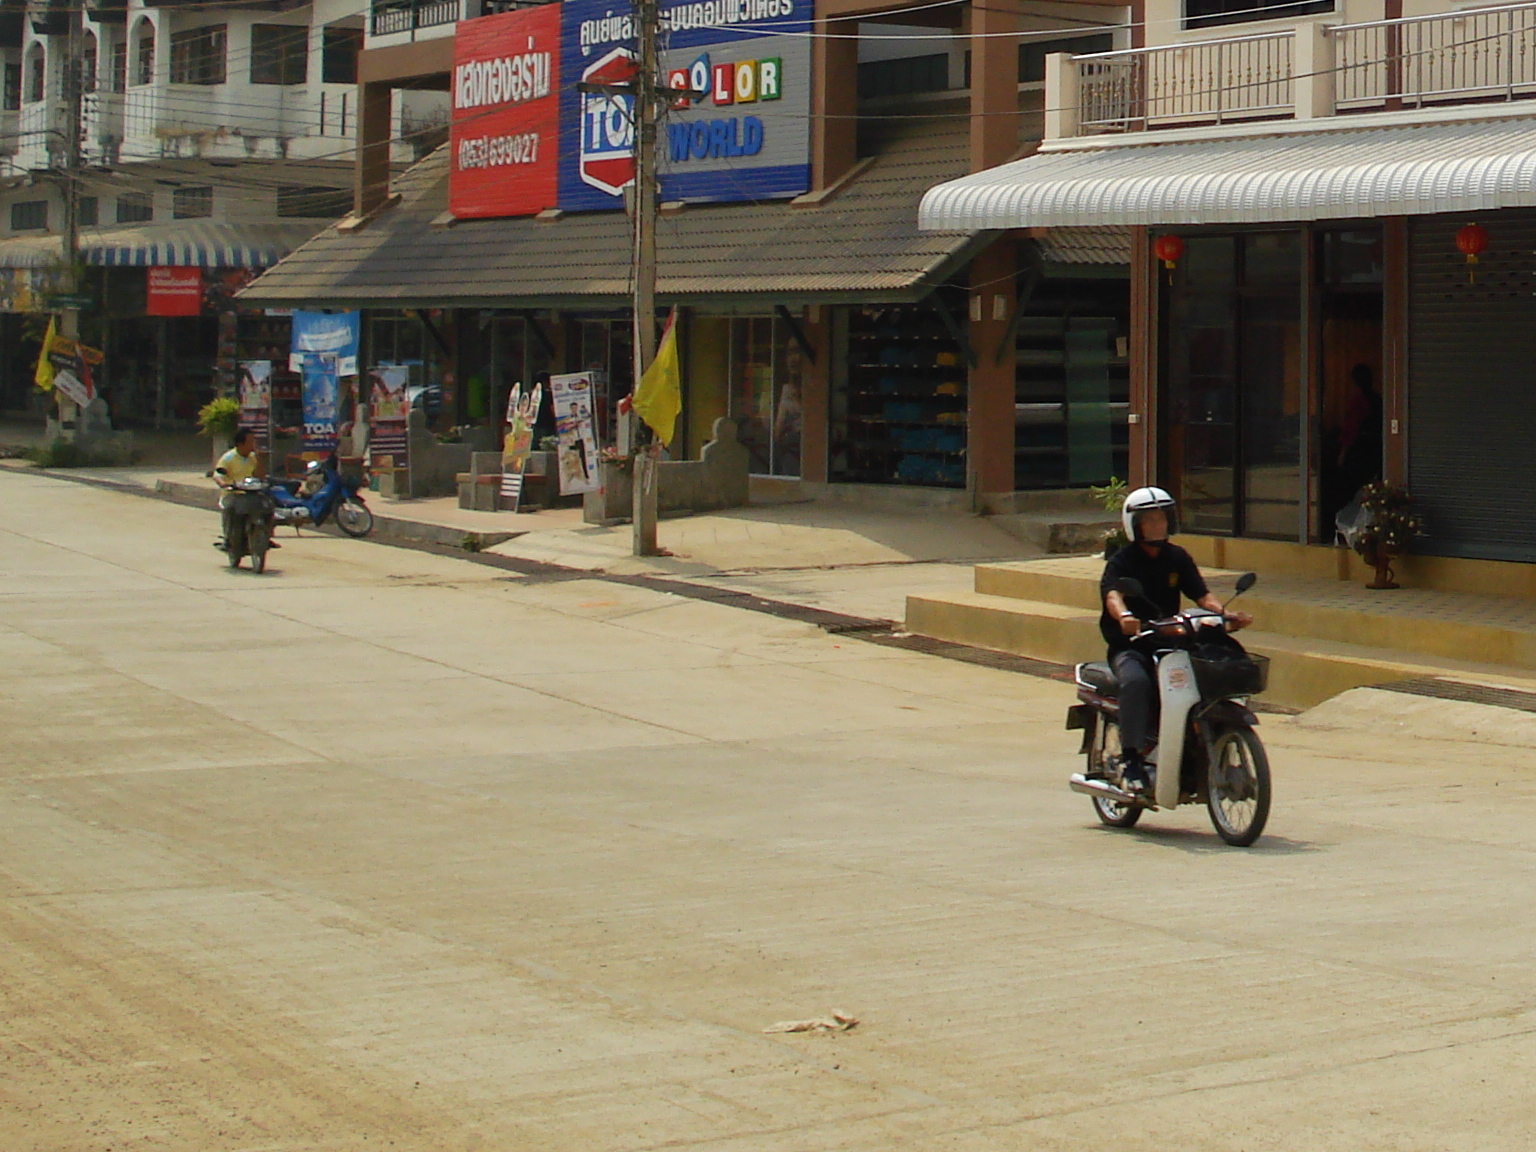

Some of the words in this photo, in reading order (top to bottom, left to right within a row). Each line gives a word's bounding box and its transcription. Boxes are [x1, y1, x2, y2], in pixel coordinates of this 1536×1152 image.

[455, 36, 551, 109] แสงทองอร่าม
[669, 60, 777, 106] COLOR
[586, 94, 635, 150] TO
[667, 116, 763, 163] WORLD
[303, 422, 336, 434] TOA
